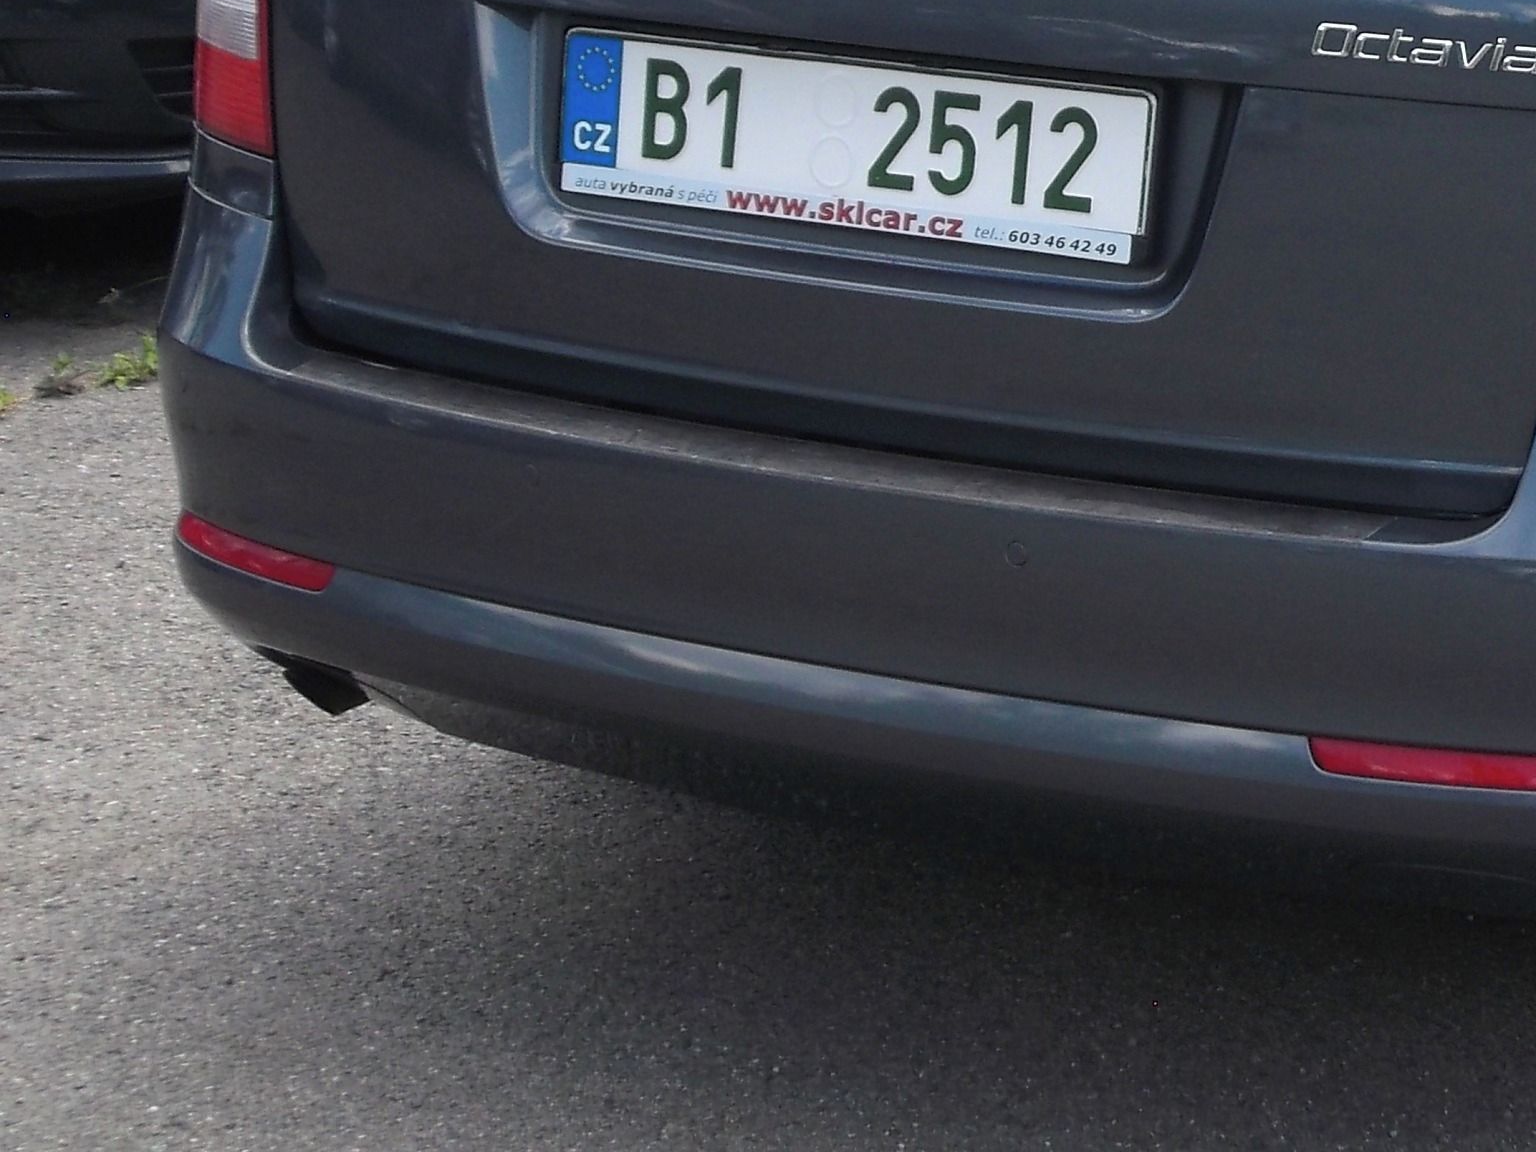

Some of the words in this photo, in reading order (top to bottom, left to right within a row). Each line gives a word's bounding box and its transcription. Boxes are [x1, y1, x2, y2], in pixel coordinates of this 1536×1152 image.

[573, 120, 612, 153] CZ
[641, 57, 743, 169] B1
[867, 86, 1099, 213] 2512
[575, 175, 606, 190] auta
[610, 179, 674, 198] vybraná
[678, 189, 685, 200] s
[725, 190, 964, 239] www.sklcar.cz
[1008, 230, 1040, 246] 603
[1044, 234, 1065, 249] 46
[1069, 238, 1091, 254] 42
[1095, 242, 1117, 257] 49
